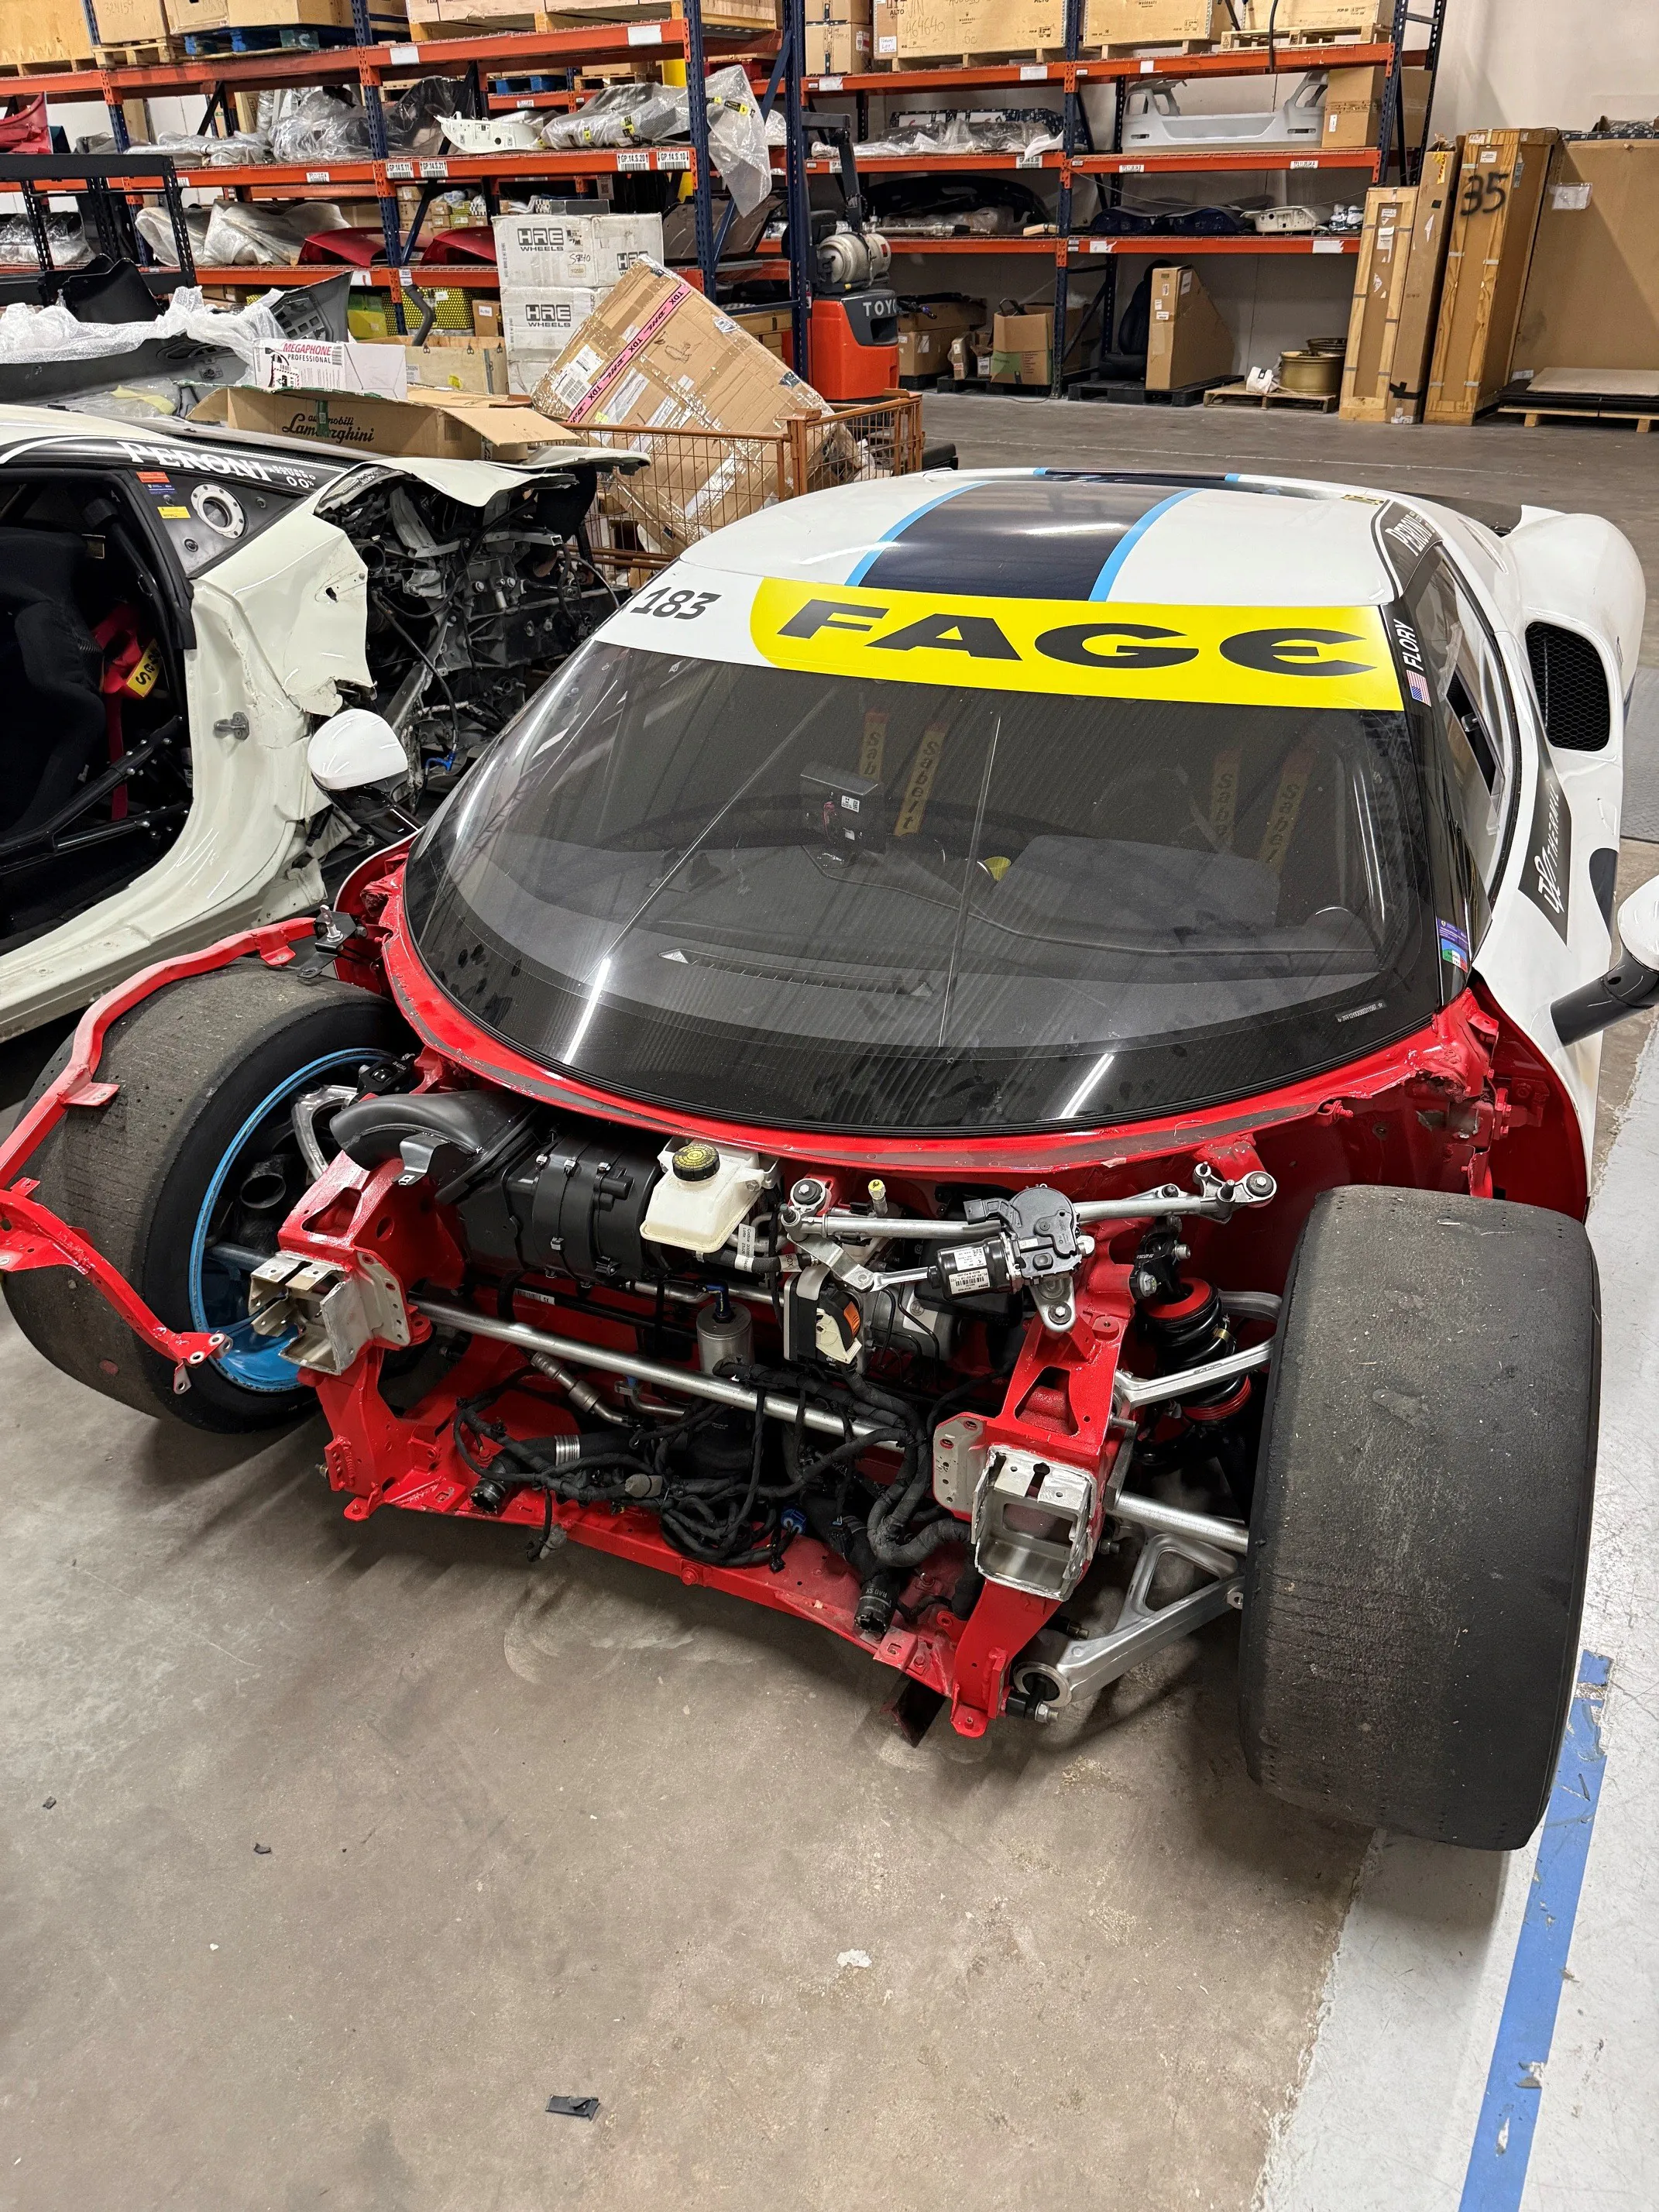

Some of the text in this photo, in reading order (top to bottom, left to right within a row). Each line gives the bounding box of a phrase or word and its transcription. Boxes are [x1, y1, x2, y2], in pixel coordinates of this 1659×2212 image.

[1461, 171, 1509, 216] 35
[517, 228, 565, 246] HRE
[617, 251, 649, 271] HR
[668, 290, 684, 305] TDX
[525, 304, 572, 322] HRE
[282, 342, 333, 356] MEGAPHONE
[628, 337, 644, 353] TDX
[287, 354, 331, 364] PROFESSIONAL
[588, 386, 603, 401] TDX
[282, 413, 375, 444] Lamrghini
[307, 414, 354, 426] aumobili
[117, 441, 273, 482] PERONI
[630, 587, 722, 620] 183
[1393, 618, 1424, 672] FLORY
[785, 1254, 794, 1268] BOX
